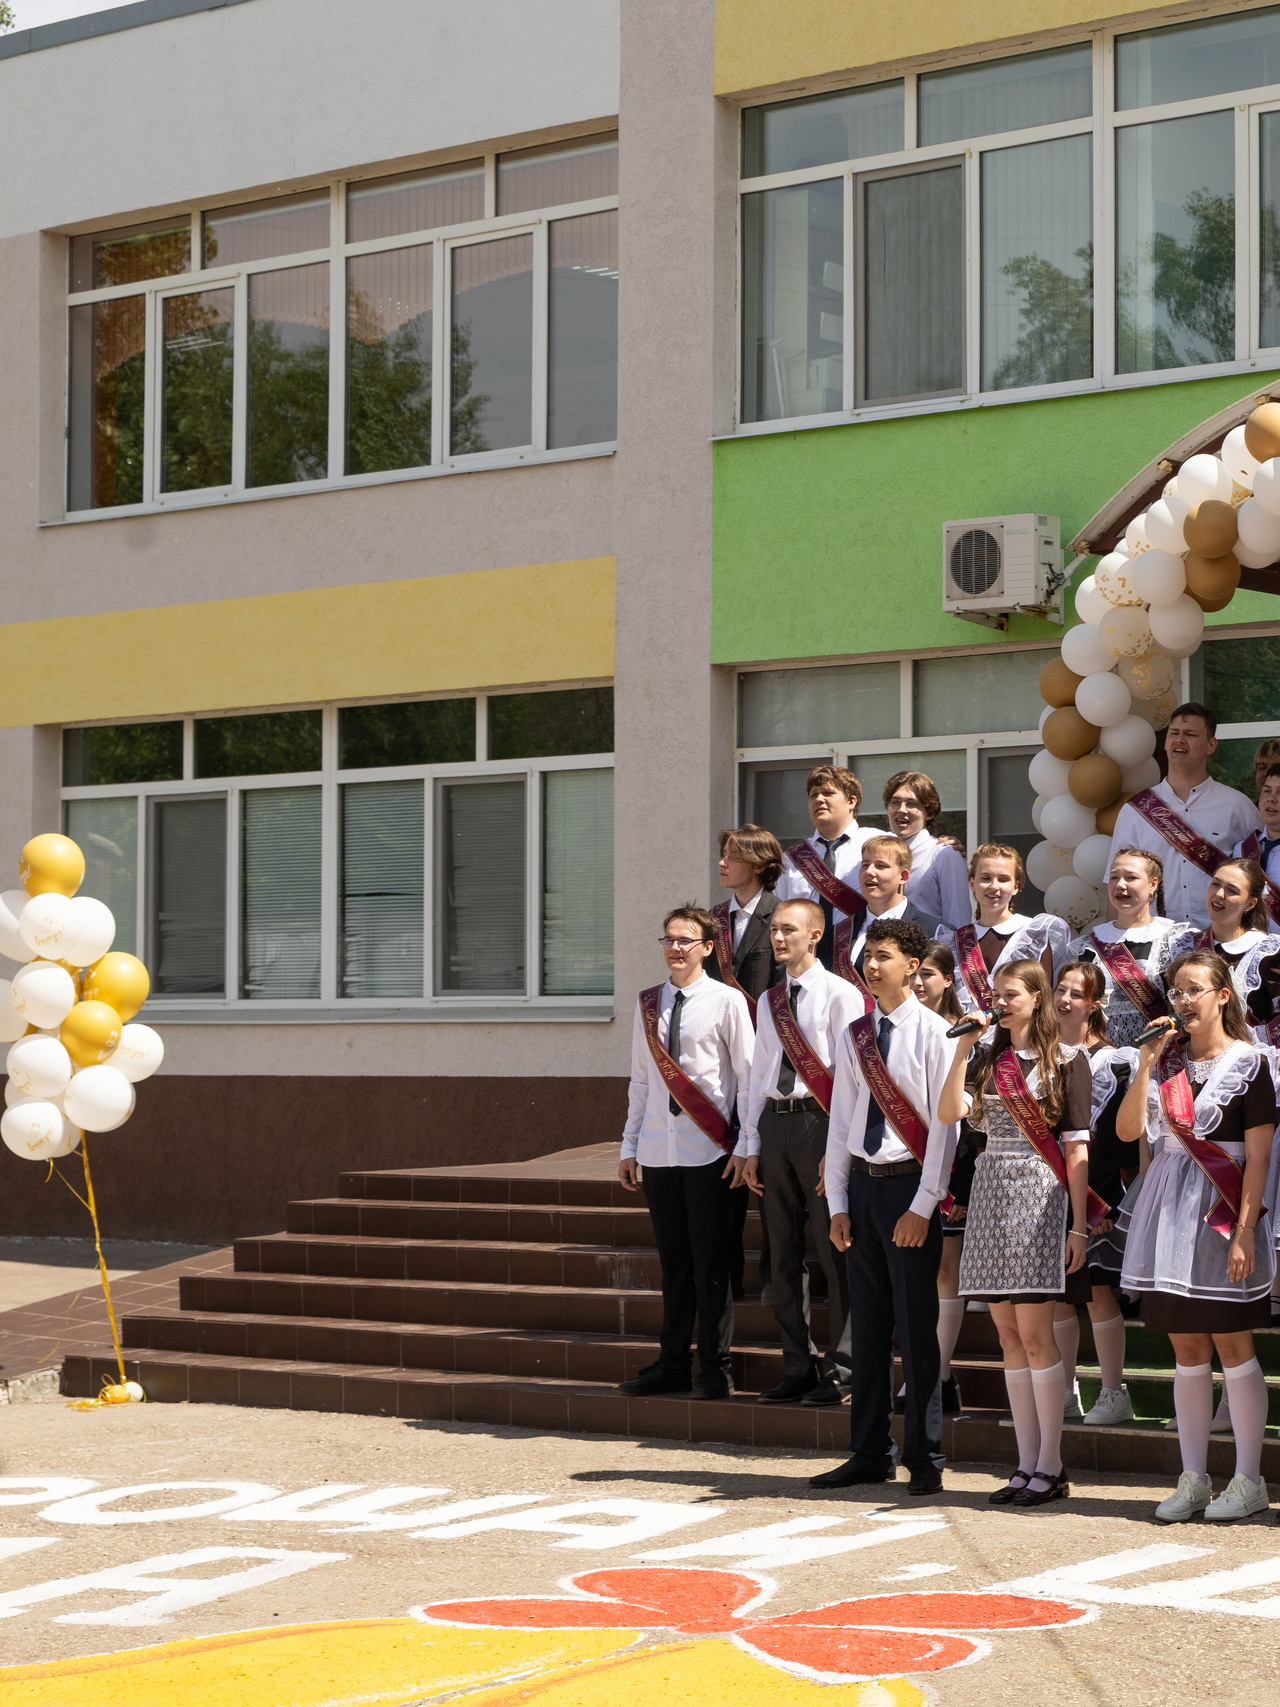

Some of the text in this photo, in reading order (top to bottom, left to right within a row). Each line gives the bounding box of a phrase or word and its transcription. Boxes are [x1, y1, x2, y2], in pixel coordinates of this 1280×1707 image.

[660, 1059, 680, 1081] 2026
[776, 1008, 805, 1058] Выпускник
[799, 1057, 823, 1079] 2026
[862, 1046, 894, 1102] Выпускник
[890, 1100, 916, 1124] 2026
[996, 1060, 1033, 1120] Выпускница
[1028, 1117, 1051, 1140] 2026
